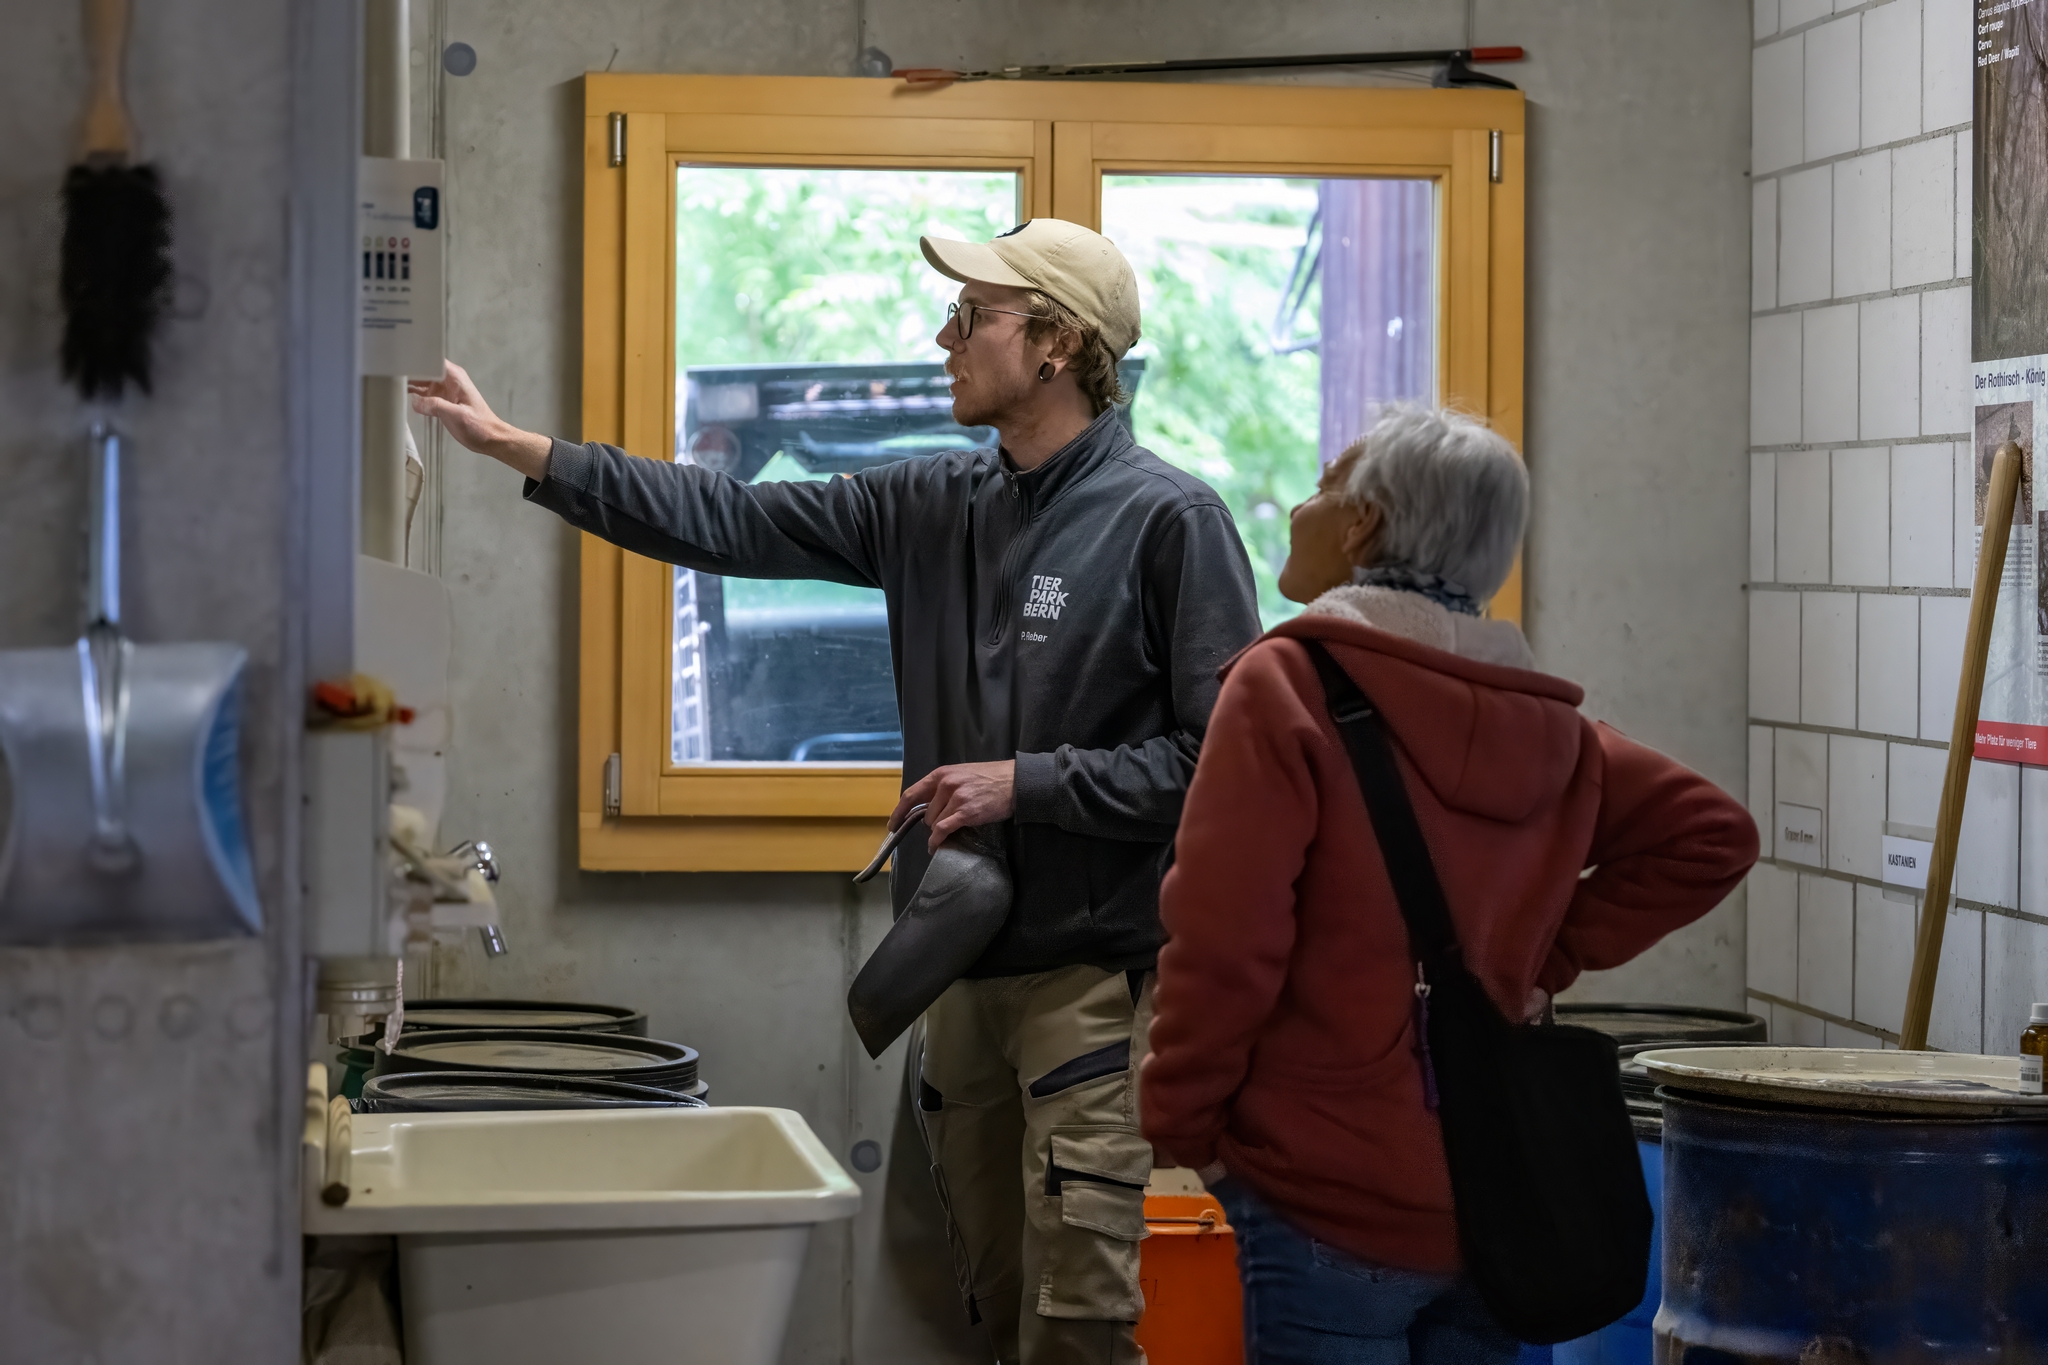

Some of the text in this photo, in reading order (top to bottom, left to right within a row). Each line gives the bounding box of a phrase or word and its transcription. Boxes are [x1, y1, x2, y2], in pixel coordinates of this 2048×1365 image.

[1978, 8, 1993, 19] Cervus
[1978, 20, 2003, 35] Cerf rouge
[1978, 40, 1992, 51] Cervo
[1978, 55, 1987, 67] Red
[1988, 53, 2000, 64] Deer
[2004, 45, 2019, 59] Wapiti
[1975, 374, 1986, 389] Der
[1988, 370, 2020, 388] Rothirsch
[2026, 367, 2045, 386] König
[1032, 575, 1062, 591] TIER
[1029, 589, 1069, 607] PARK
[1023, 603, 1060, 620] BERN
[1975, 733, 1986, 744] Mehr
[1987, 733, 1998, 746] Platz
[2006, 737, 2024, 750] weniger
[2025, 738, 2037, 749] Tiere
[1888, 853, 1916, 869] KASTANIEN
